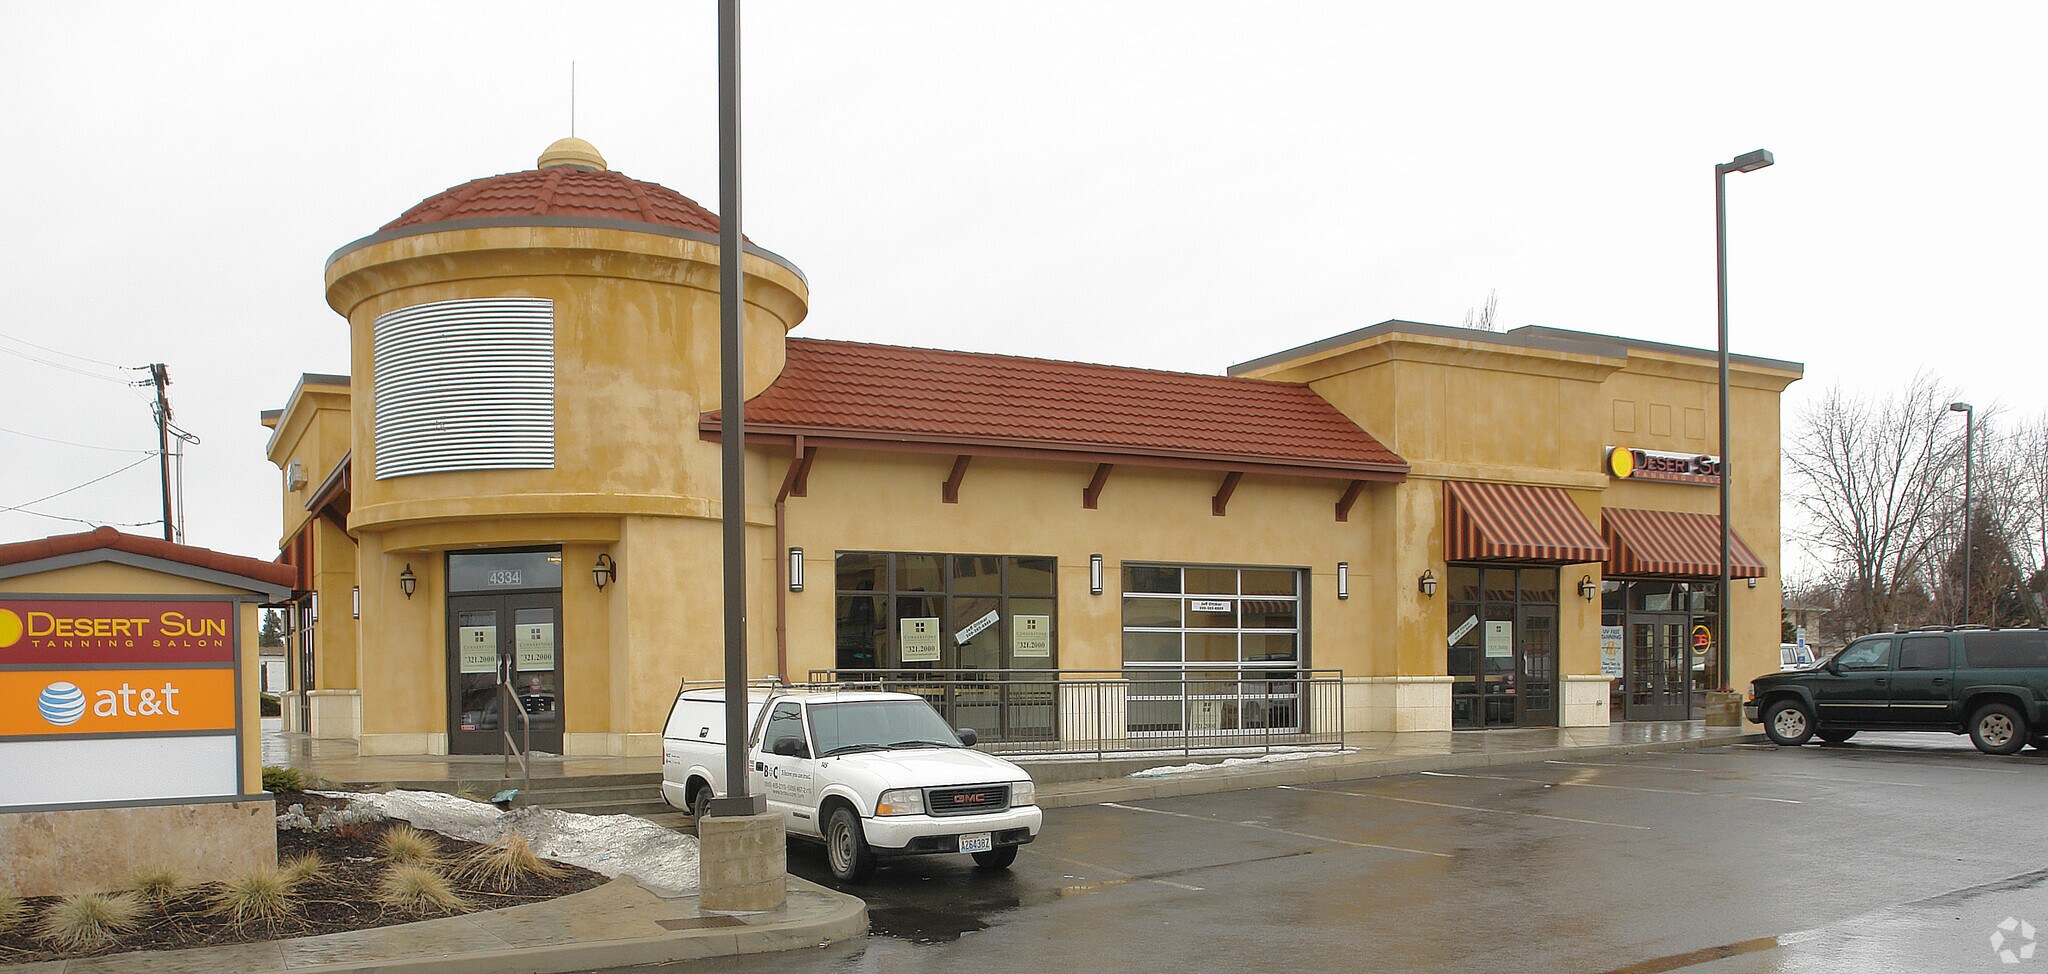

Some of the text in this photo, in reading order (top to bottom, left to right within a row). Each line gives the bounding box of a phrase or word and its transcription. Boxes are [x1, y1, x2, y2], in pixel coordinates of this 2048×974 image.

[1633, 450, 1721, 475] DESERT SU
[1634, 470, 1687, 481] TANNING
[490, 571, 520, 584] 4334
[27, 611, 226, 637] DESERT SUN
[32, 639, 223, 648] TANNING SALON
[93, 682, 180, 717] at&t
[954, 793, 985, 803] GMC
